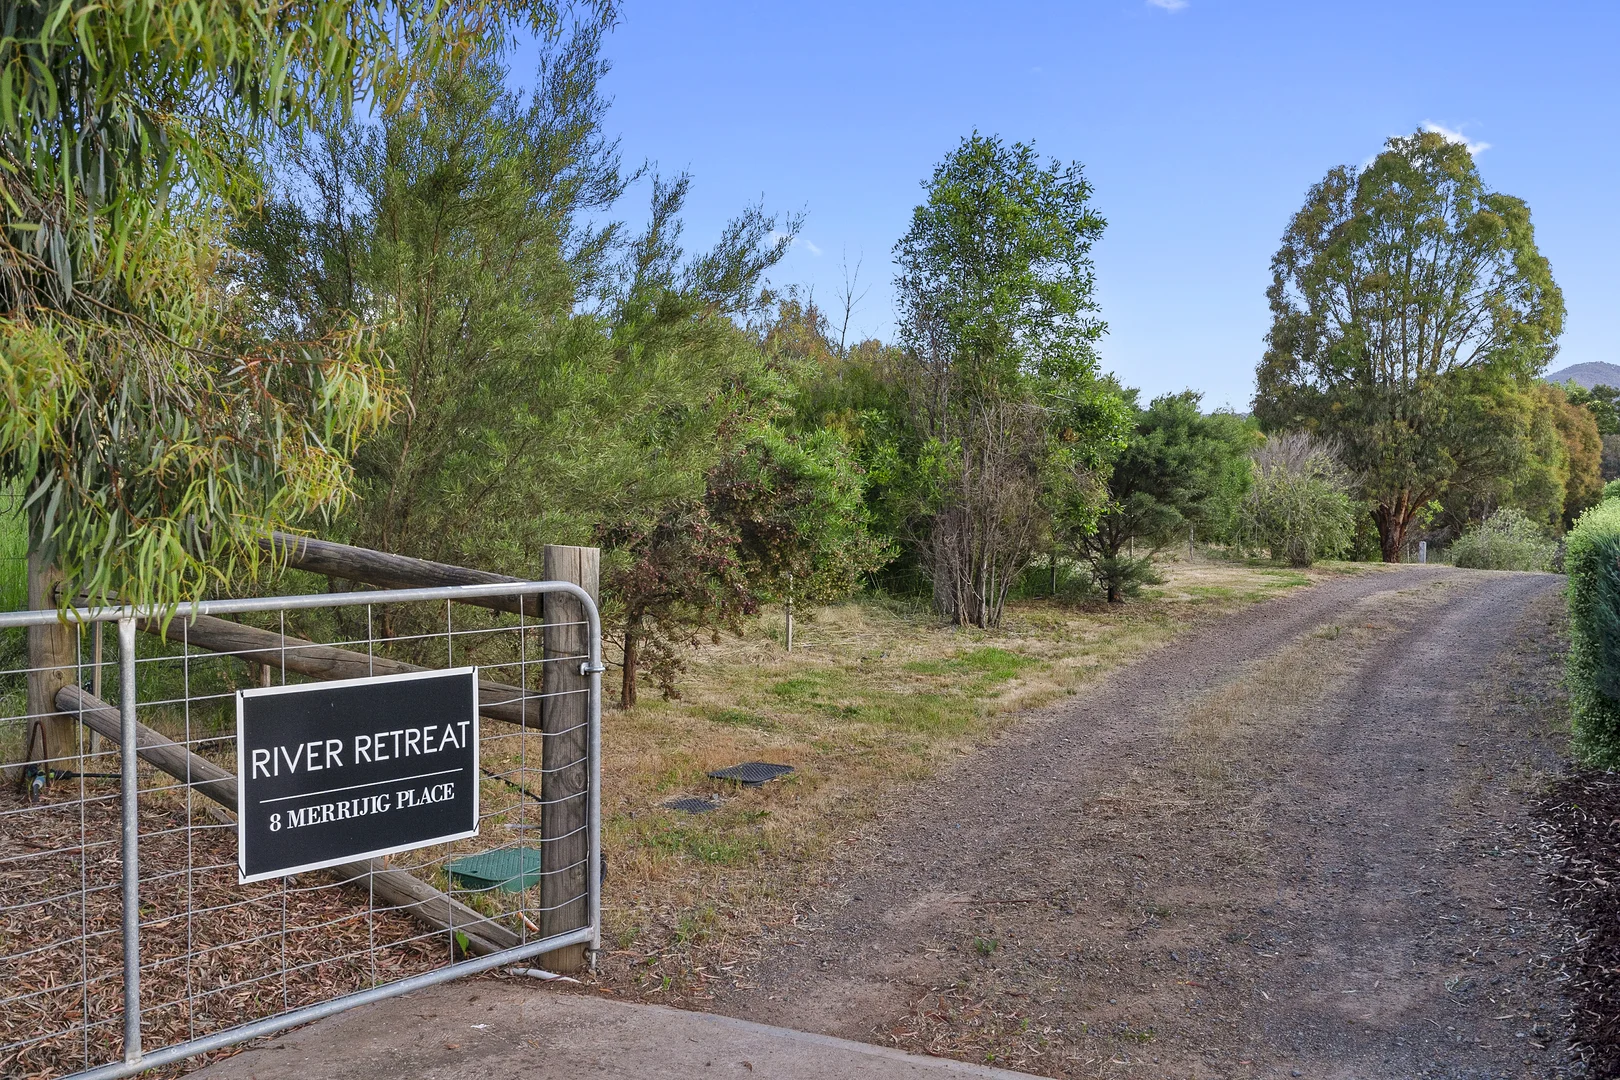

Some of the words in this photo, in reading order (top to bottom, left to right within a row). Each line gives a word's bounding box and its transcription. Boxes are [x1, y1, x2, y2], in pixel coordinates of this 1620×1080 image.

[252, 739, 343, 779] RIVER
[355, 720, 470, 764] RETREAT
[269, 813, 281, 832] 8
[287, 794, 391, 829] MERRIJIG
[396, 782, 455, 810] PLACE
